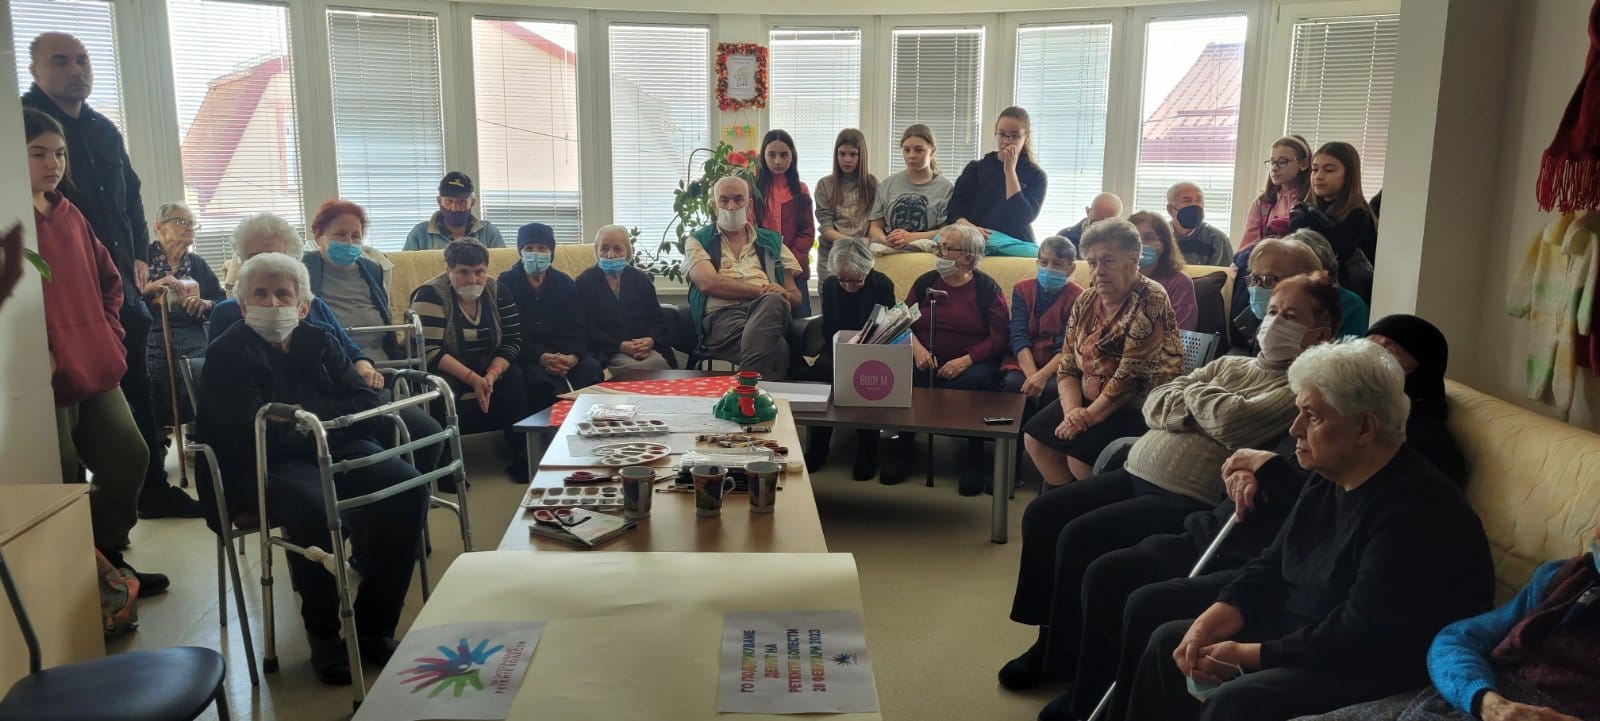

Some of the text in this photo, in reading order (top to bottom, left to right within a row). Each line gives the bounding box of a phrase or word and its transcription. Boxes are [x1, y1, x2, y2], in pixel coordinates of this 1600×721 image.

[808, 629, 822, 645] 2023
[764, 643, 781, 678] ДЕНОТ НА
[786, 629, 802, 693] РЕТКИТЕ БОЛЕСТИ
[741, 683, 755, 693] ГО
[812, 683, 826, 692] 28
